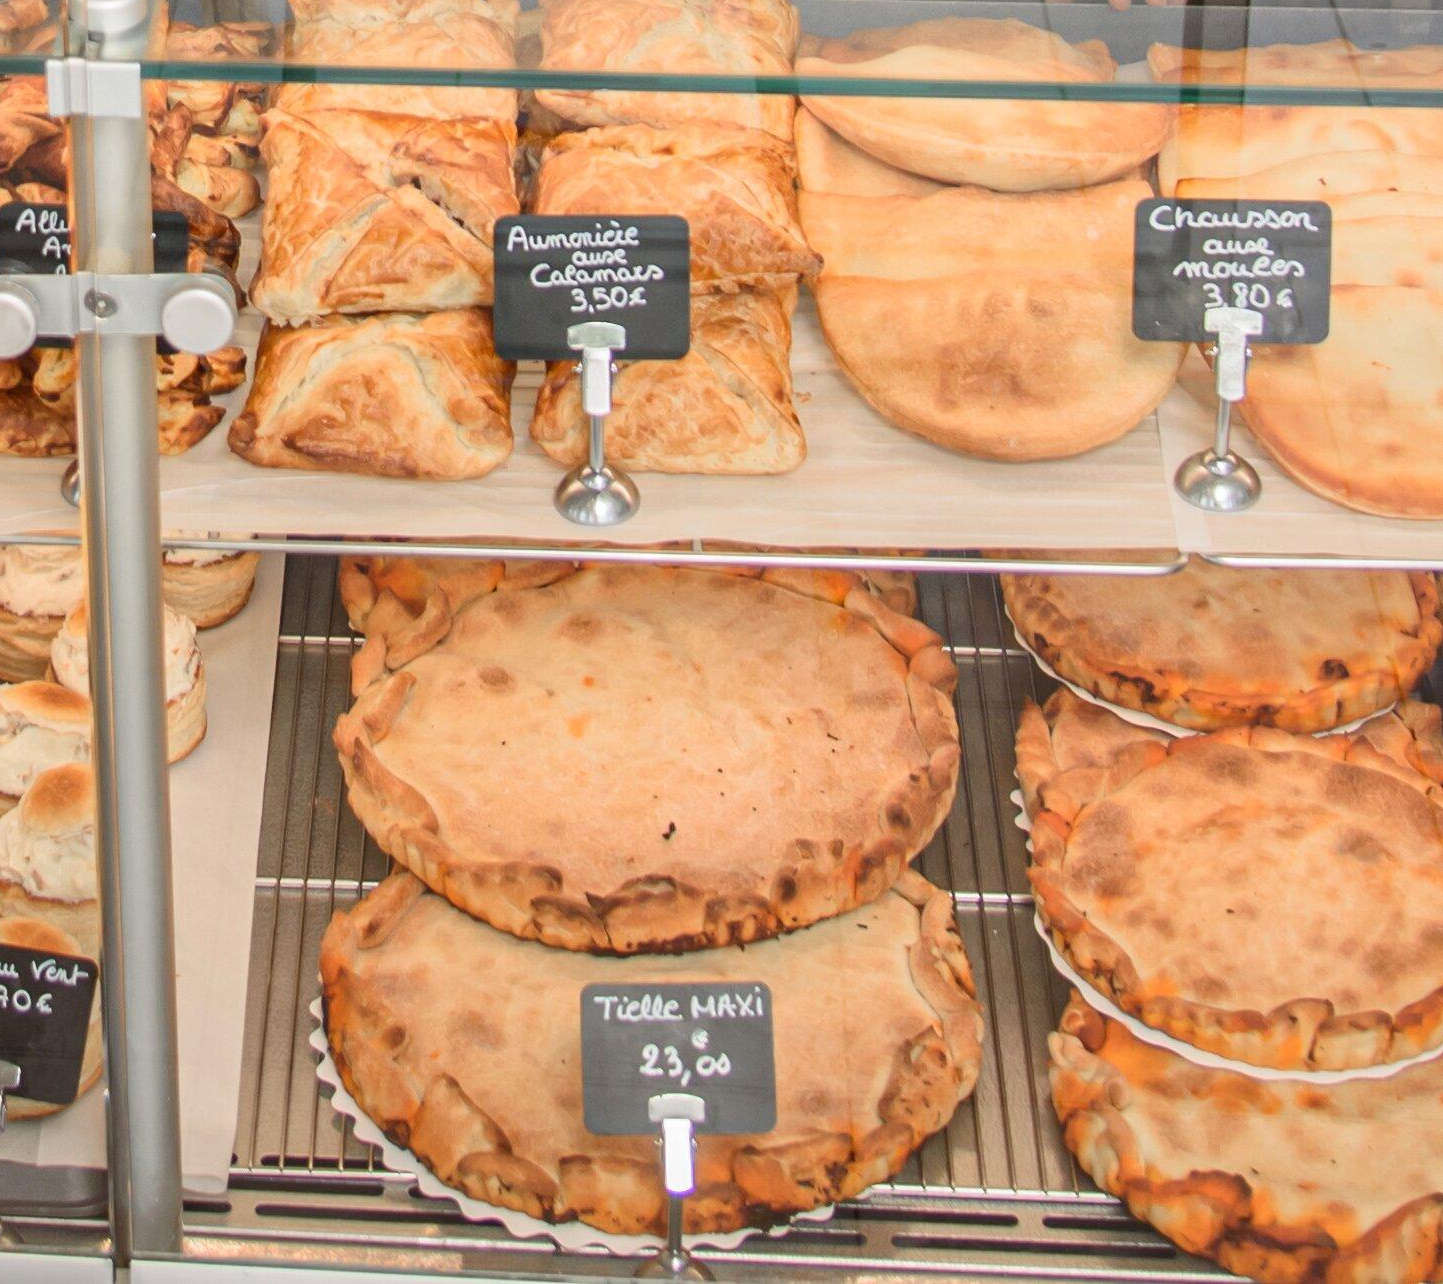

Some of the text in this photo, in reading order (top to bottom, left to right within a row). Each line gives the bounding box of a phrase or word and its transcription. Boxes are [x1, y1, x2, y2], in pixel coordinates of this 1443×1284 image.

[1148, 204, 1319, 233] Chausson
[1172, 256, 1306, 279] moules
[593, 993, 683, 1022] Tielle
